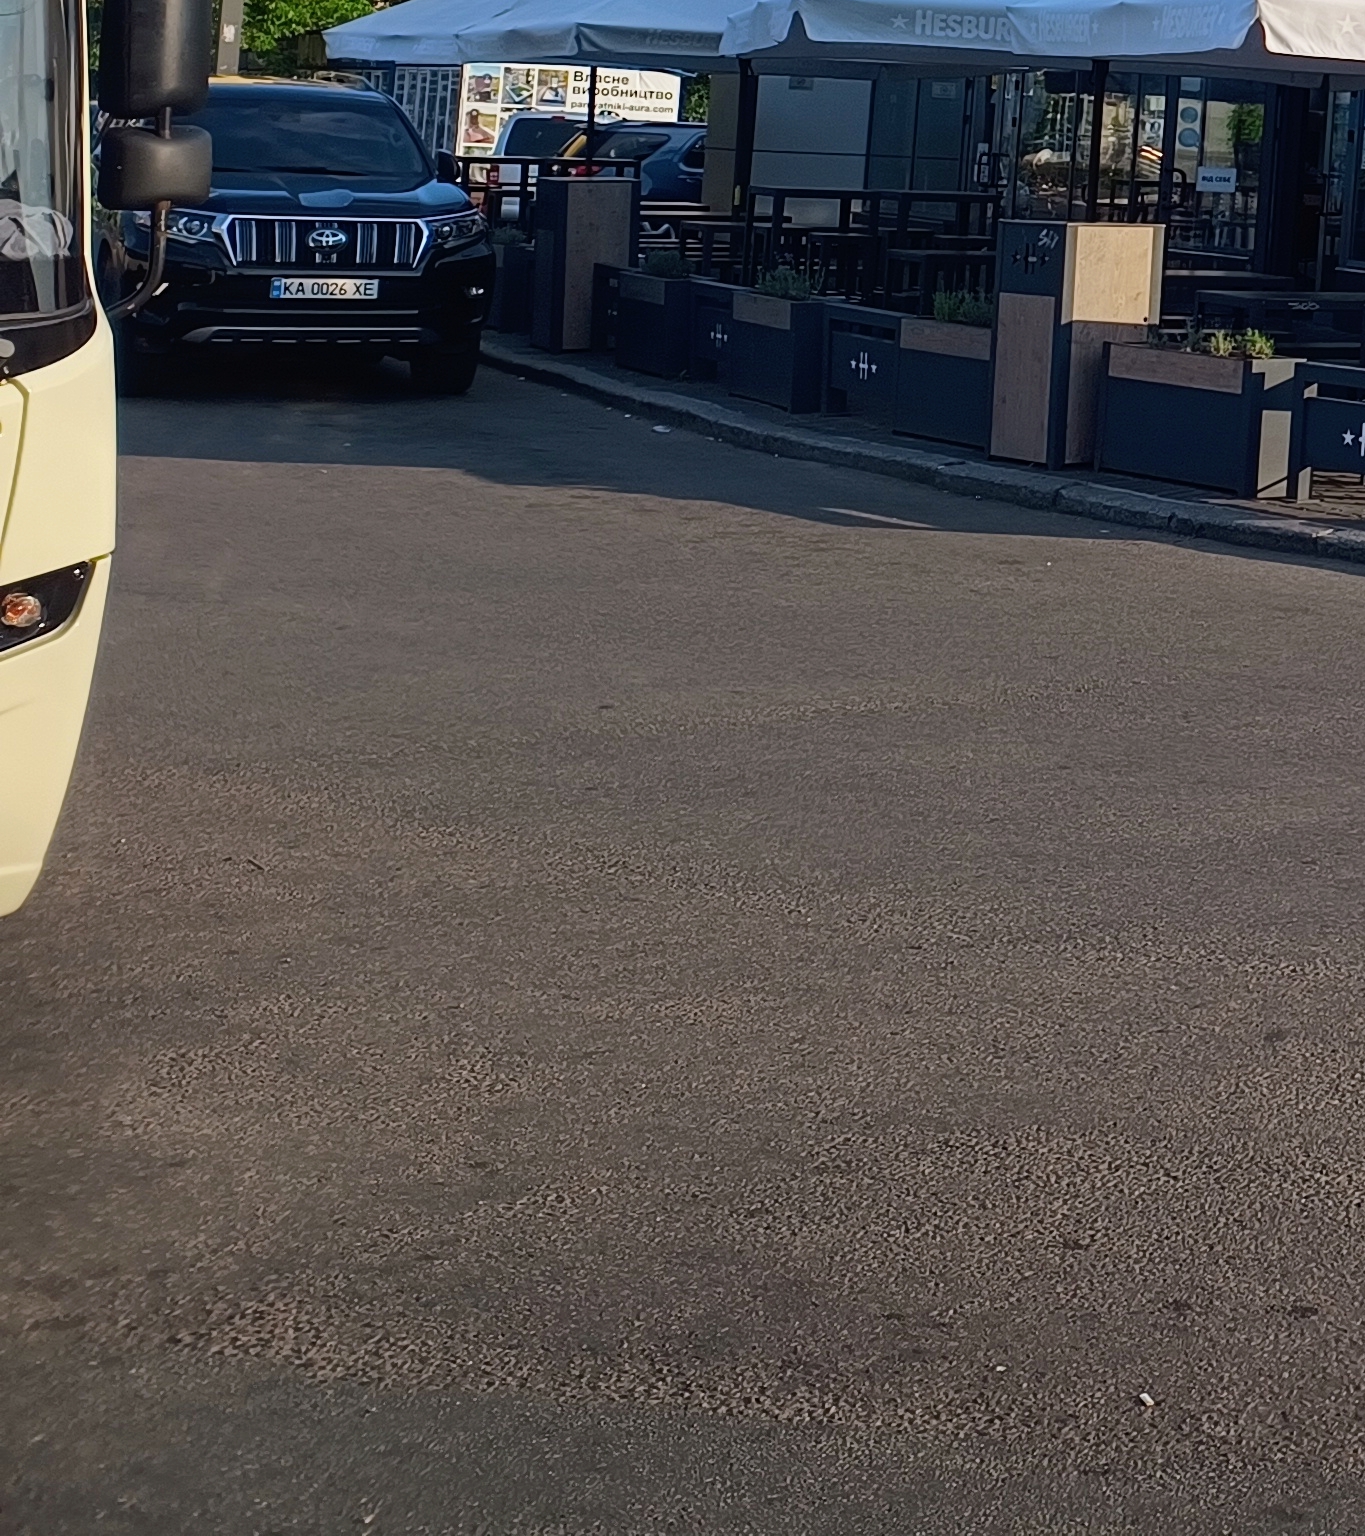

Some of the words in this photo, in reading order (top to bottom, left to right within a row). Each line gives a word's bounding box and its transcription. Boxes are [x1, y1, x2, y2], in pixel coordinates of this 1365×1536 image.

[915, 10, 1011, 41] HESBUR
[283, 281, 305, 296] KA
[311, 282, 347, 296] 0026
[352, 282, 375, 296] XE
